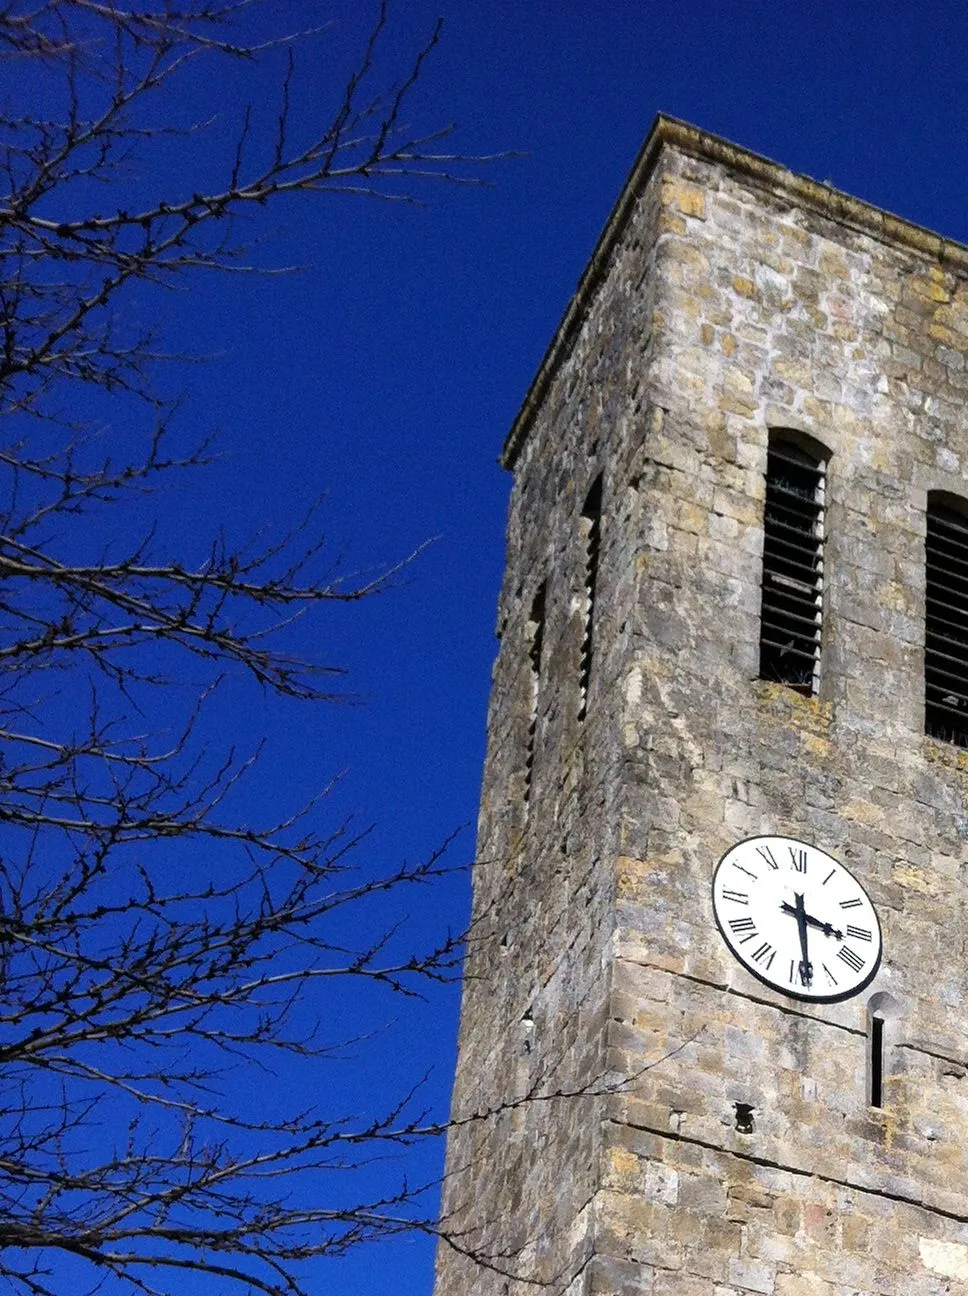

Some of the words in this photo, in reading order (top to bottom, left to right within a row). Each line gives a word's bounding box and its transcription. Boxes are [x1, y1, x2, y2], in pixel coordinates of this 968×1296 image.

[788, 846, 807, 874] XII
[822, 869, 836, 885] I
[839, 898, 863, 909] II
[728, 917, 759, 944] VIII
[847, 925, 872, 942] III
[751, 942, 777, 970] VII
[836, 945, 866, 973] IIII
